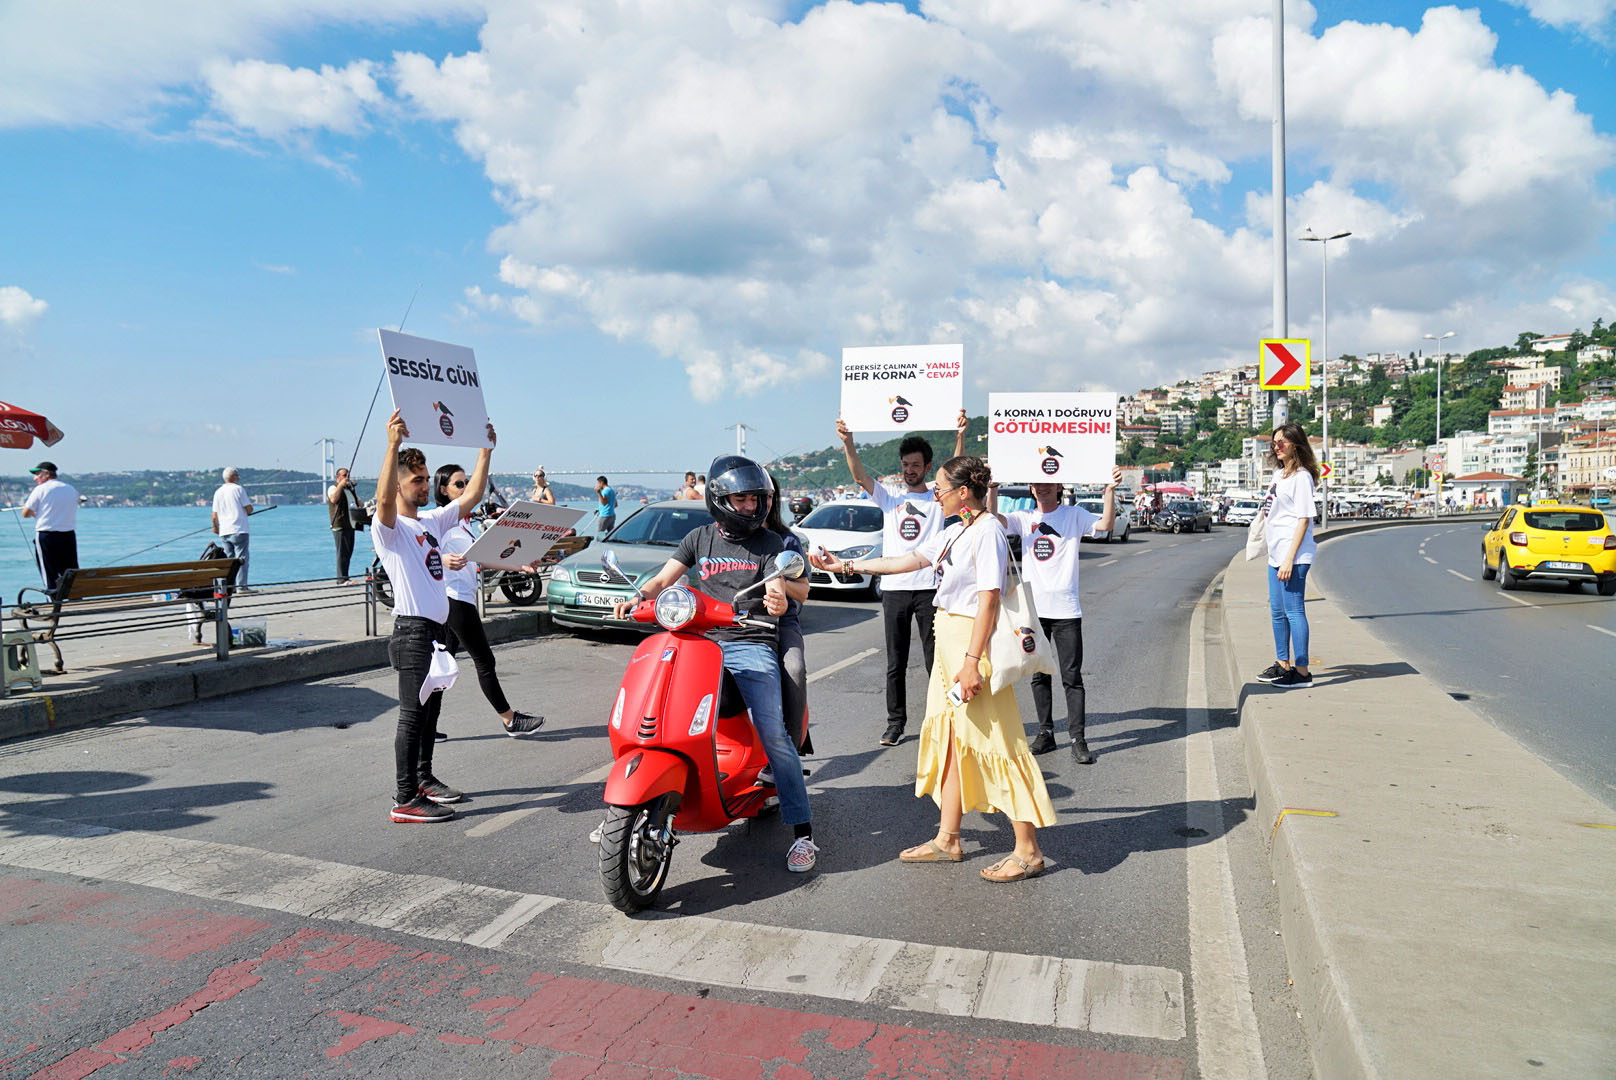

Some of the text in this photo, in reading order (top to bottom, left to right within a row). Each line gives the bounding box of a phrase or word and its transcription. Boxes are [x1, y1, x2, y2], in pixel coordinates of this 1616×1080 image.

[845, 363, 918, 372] GEREKSİZ ÇALINAN
[926, 362, 960, 370] YANLIŞ
[388, 357, 479, 387] SESSİZ GÜN
[845, 372, 869, 381] HER
[873, 371, 916, 380] KORNA
[926, 371, 959, 379] CEVAP
[993, 407, 1112, 418] 4 KORNA 1 DOĞRUYU
[993, 418, 1111, 434] GÖTÜRMESİN!
[506, 510, 533, 520] YARIN
[496, 518, 570, 534] ÜNİVERSİTE SINAVI
[699, 558, 758, 580] SUPERMAN
[583, 595, 592, 603] 34
[594, 596, 611, 605] GNK
